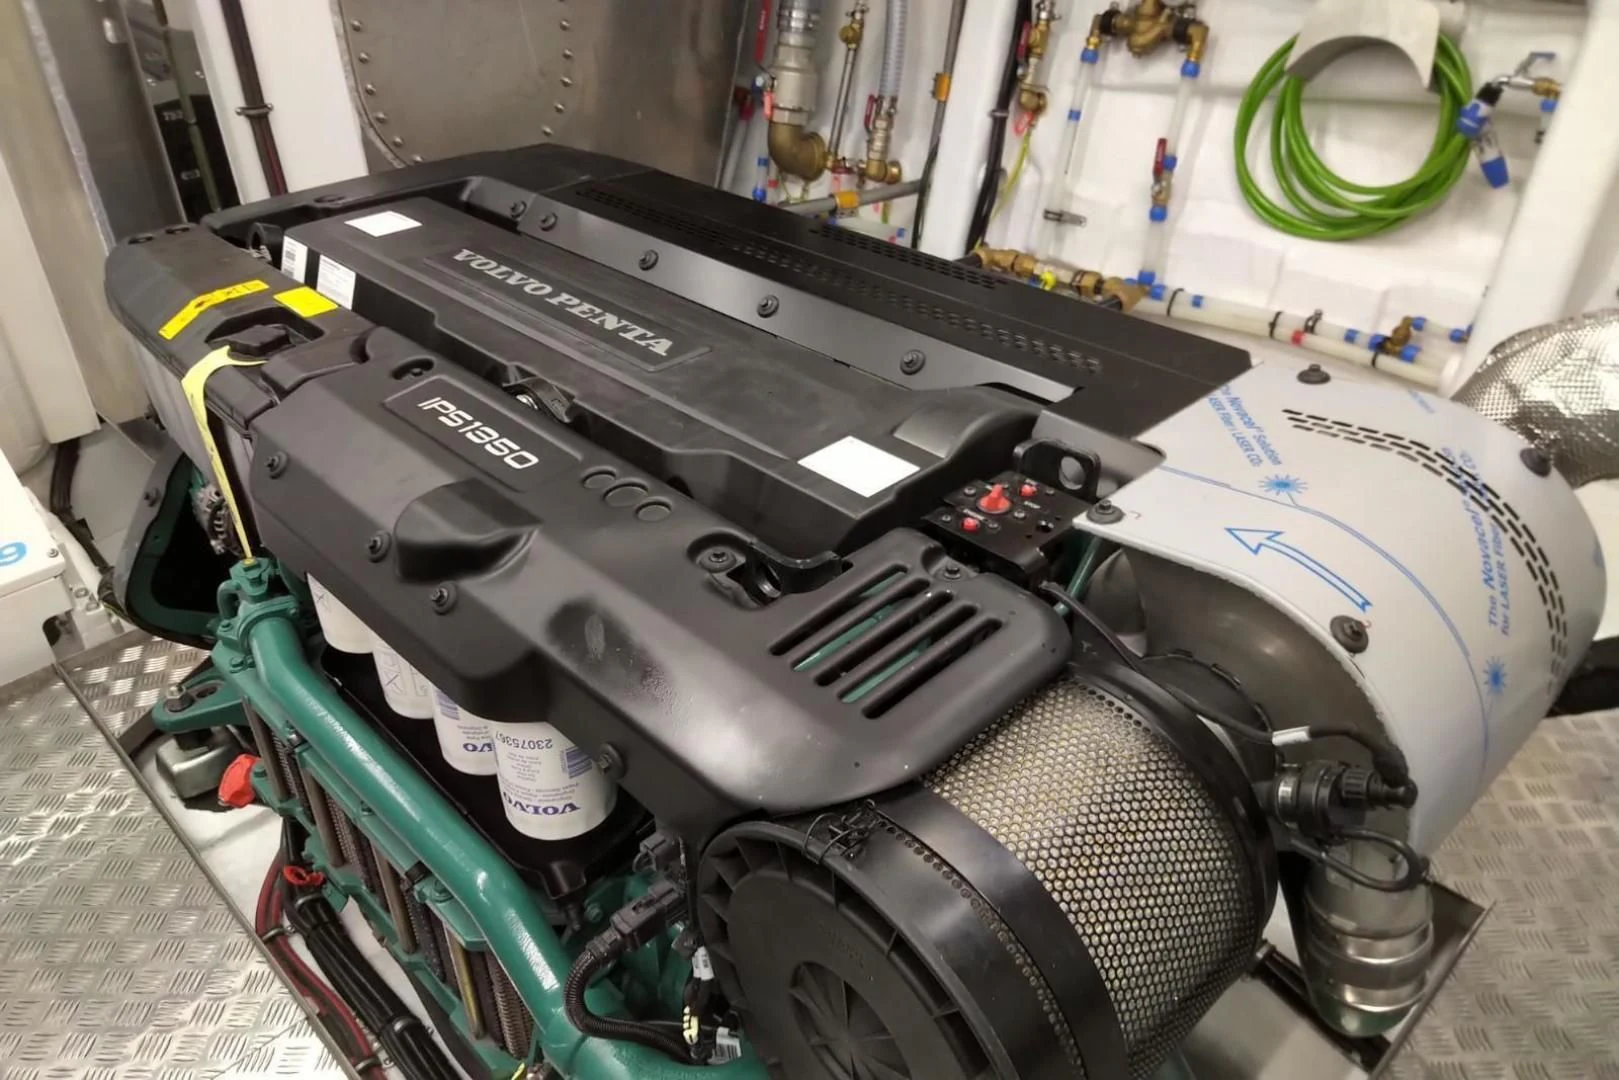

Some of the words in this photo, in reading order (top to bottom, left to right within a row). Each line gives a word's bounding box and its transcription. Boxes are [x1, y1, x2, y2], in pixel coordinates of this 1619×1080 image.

[452, 249, 553, 296] VOLVO
[544, 292, 675, 357] PENTA
[417, 397, 539, 469] IPS1350
[1497, 560, 1510, 609] LASER
[1488, 595, 1498, 627] The
[502, 791, 581, 815] VOLVO
